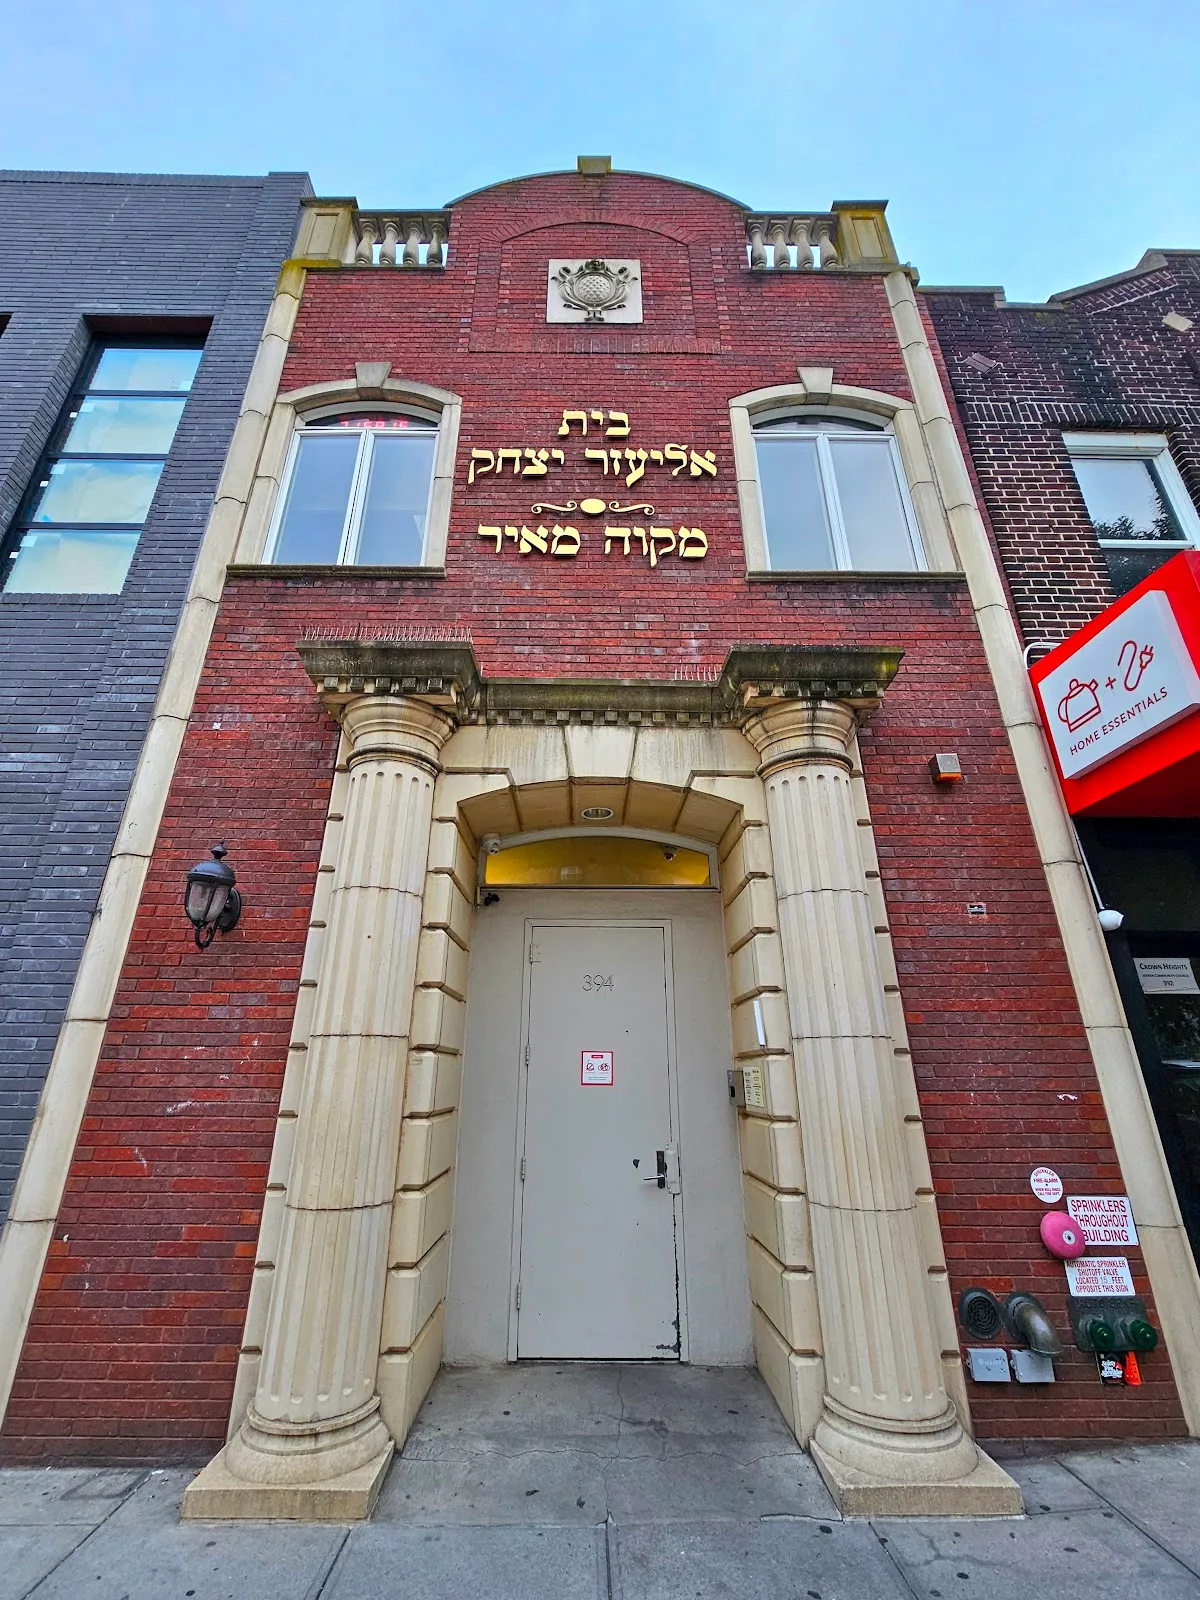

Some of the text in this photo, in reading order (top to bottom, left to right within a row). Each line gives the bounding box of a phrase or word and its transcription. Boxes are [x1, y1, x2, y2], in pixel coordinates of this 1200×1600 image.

[557, 409, 631, 436] בית
[467, 443, 718, 488] אליעזר יצחק
[477, 523, 708, 567] מקוה מאיר
[1069, 686, 1168, 756] HOME ESSENTIALS
[582, 974, 614, 992] 394
[1070, 1199, 1127, 1213] SPRINKLERS
[1073, 1214, 1129, 1228] THROUGHOUT
[1081, 1229, 1130, 1242] BUILDING
[1066, 1260, 1127, 1268] AUTOMATIC SPRINKLER
[1077, 1268, 1119, 1276] SHUTOFF VALVE
[1075, 1276, 1099, 1285] LOCATED
[1111, 1276, 1125, 1284] FEET
[1075, 1285, 1102, 1293] OPPOSITE
